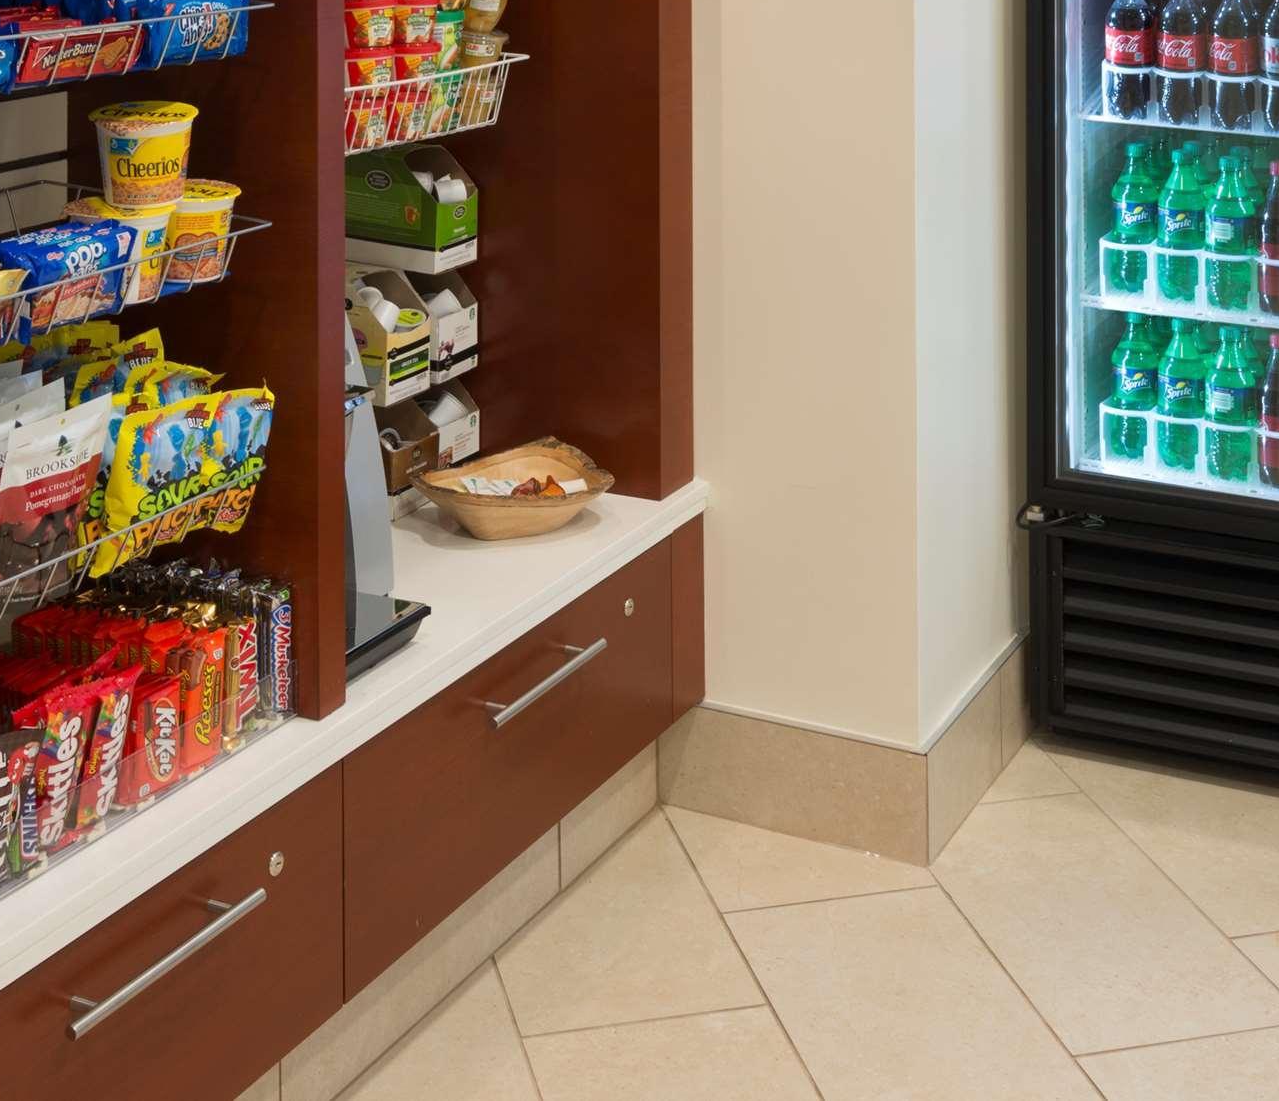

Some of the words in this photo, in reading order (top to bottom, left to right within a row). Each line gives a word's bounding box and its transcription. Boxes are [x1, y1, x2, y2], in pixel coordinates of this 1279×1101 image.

[101, 108, 189, 119] Cheerios
[116, 157, 180, 179] Cheerios
[1121, 207, 1151, 226] Sprite
[1166, 215, 1194, 232] Sprite
[1121, 374, 1151, 393] Sprite
[1166, 383, 1194, 400] Sprite
[25, 449, 90, 480] BROOKSIDE
[209, 456, 265, 490] SOUR
[29, 486, 48, 499] DARK
[48, 472, 86, 492] CHOCOLATE
[138, 474, 201, 520] SOUR
[275, 626, 292, 711] Musketeer
[194, 662, 217, 745] Reese's
[155, 706, 176, 738] Kit
[95, 692, 129, 817] Skittles
[154, 738, 176, 775] Kat
[40, 715, 82, 846] Skittles
